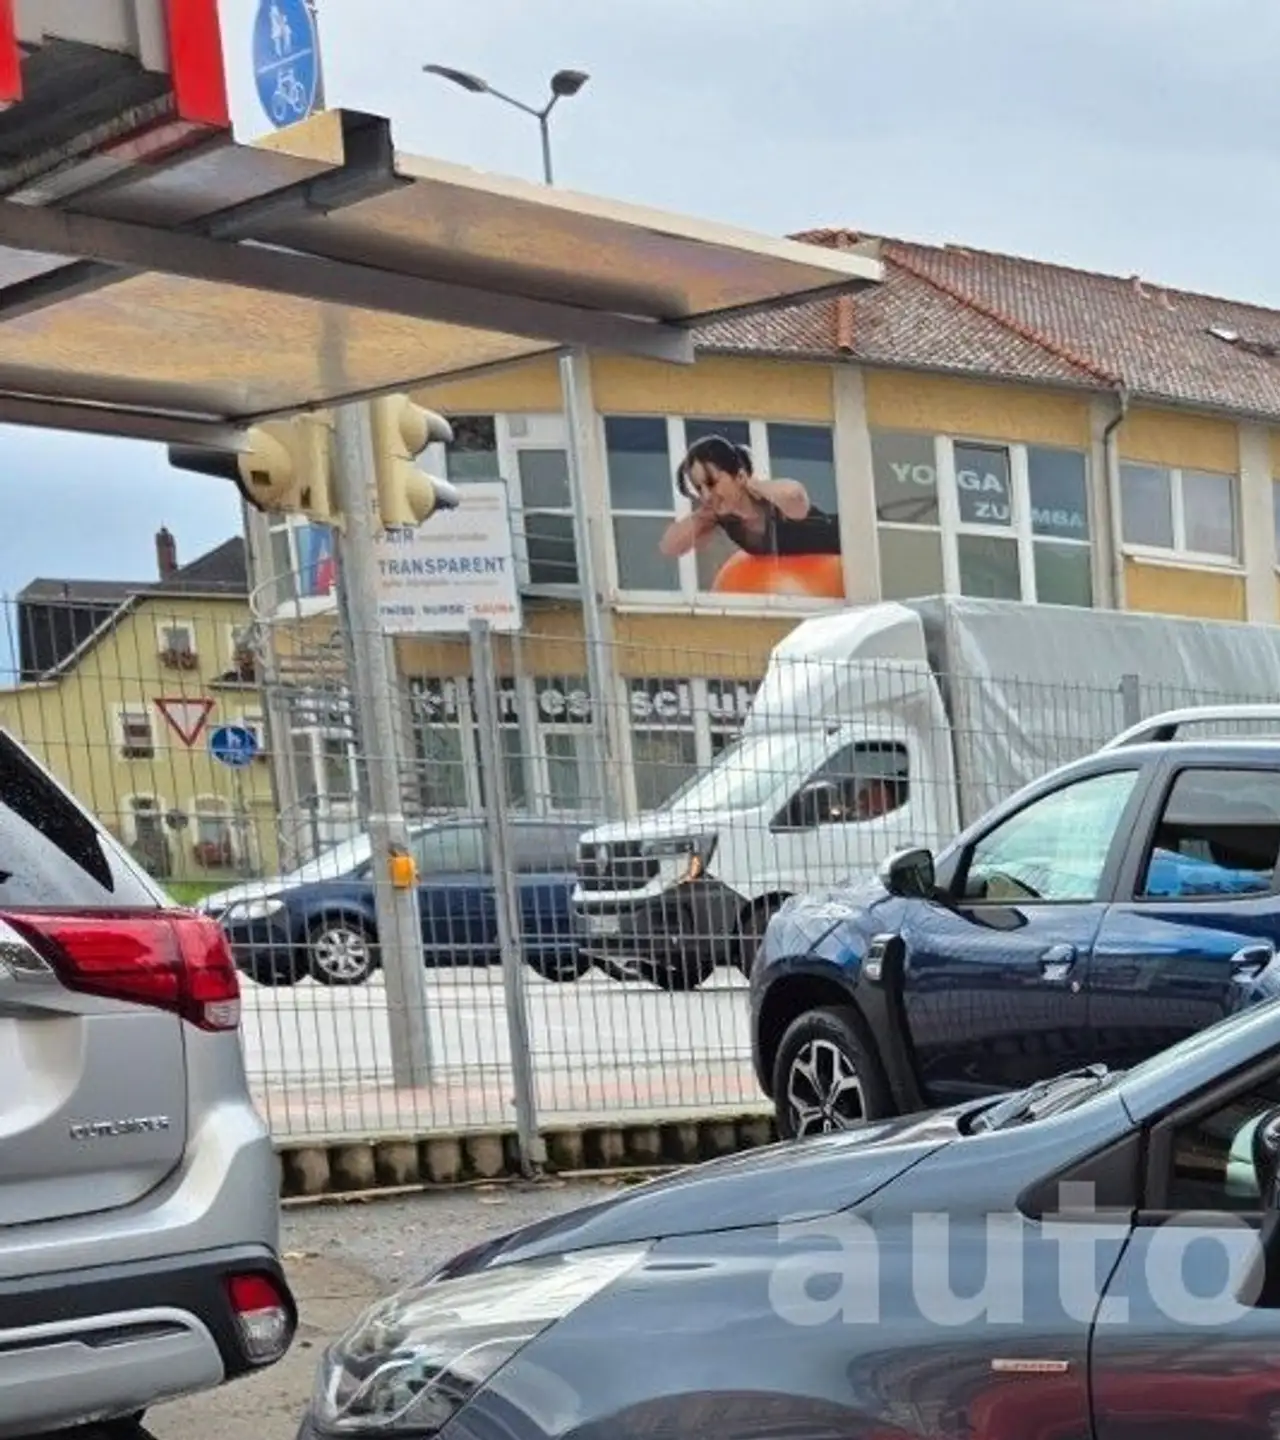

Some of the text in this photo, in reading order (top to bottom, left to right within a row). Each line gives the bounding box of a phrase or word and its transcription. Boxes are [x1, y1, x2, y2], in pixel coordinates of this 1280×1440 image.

[889, 462, 1003, 493] YOGA
[974, 501, 1083, 528] ZUMBA
[377, 556, 507, 576] TRANSPARENT
